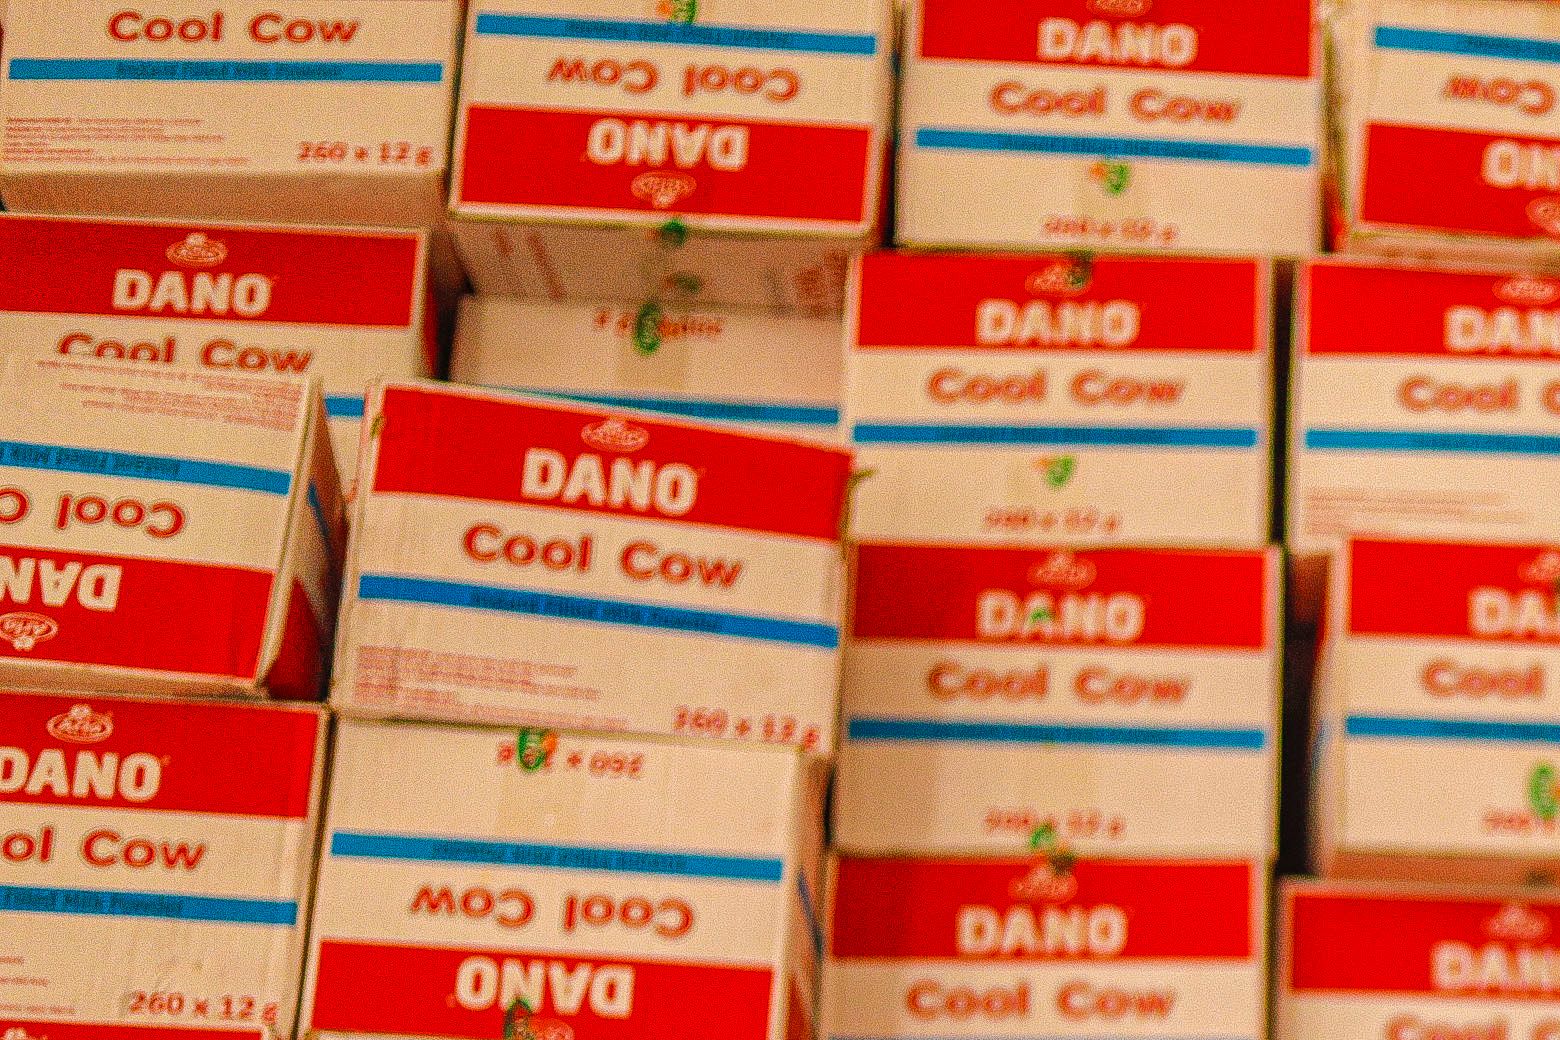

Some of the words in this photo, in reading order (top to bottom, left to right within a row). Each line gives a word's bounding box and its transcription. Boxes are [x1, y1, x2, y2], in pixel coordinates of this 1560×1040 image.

[107, 11, 224, 43] Cool
[248, 12, 359, 44] Cow
[1038, 18, 1197, 66] DANO
[547, 58, 659, 94] Cow
[682, 65, 801, 103] Cool
[1444, 76, 1556, 117] Cow
[988, 81, 1107, 117] Cool
[1129, 88, 1239, 123] Cow
[587, 119, 748, 170] DANO
[113, 269, 271, 316] DANO
[977, 300, 1139, 347] DANO
[200, 339, 312, 374] Cow
[926, 368, 1048, 404] Cool
[1069, 370, 1183, 406] Cow
[1397, 375, 1520, 413] Cool
[522, 448, 697, 515] DANO
[55, 494, 186, 539] Cool
[462, 523, 593, 572] Cool
[619, 541, 742, 588] Cow
[0, 556, 122, 611] DAN
[921, 659, 1049, 702] Cool
[1072, 667, 1189, 704] Cow
[1420, 659, 1545, 699] Cool
[0, 751, 161, 801] DANO
[81, 829, 206, 871] Cow
[410, 886, 536, 928] Cow
[563, 895, 695, 938] Cool
[958, 907, 1130, 958] DANO
[456, 957, 634, 1017] DANO
[902, 980, 1031, 1021] Cool
[1055, 982, 1174, 1020] Cow
[128, 991, 185, 1015] 260
[222, 996, 255, 1020] 12
[261, 1004, 278, 1027] g
